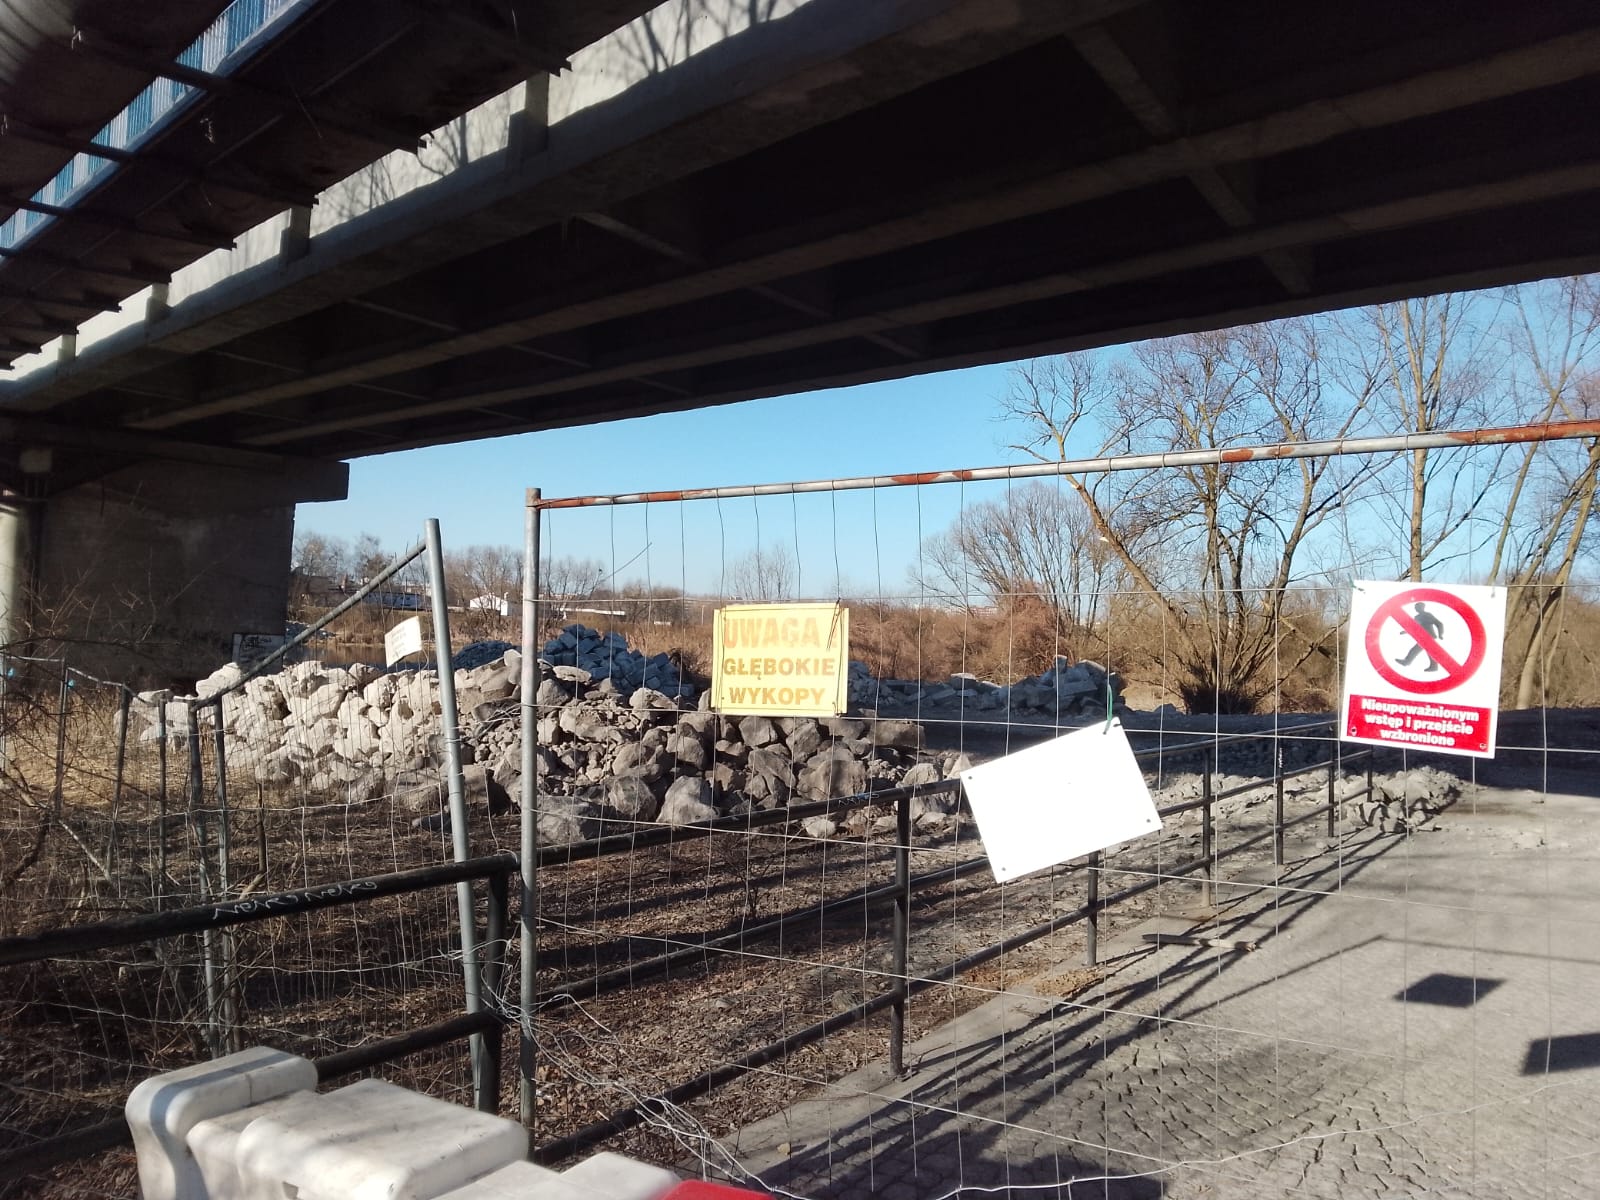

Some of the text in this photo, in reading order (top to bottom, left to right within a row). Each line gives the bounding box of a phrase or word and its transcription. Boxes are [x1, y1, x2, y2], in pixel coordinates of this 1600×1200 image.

[725, 617, 820, 649] UWAGA
[723, 657, 836, 680] GŁĘBOKIE
[729, 687, 826, 705] WYKOPY
[1361, 698, 1480, 722] Nieupoważnionym
[1364, 714, 1474, 735] wstęp i przejście
[1379, 729, 1456, 746] wzbronione
